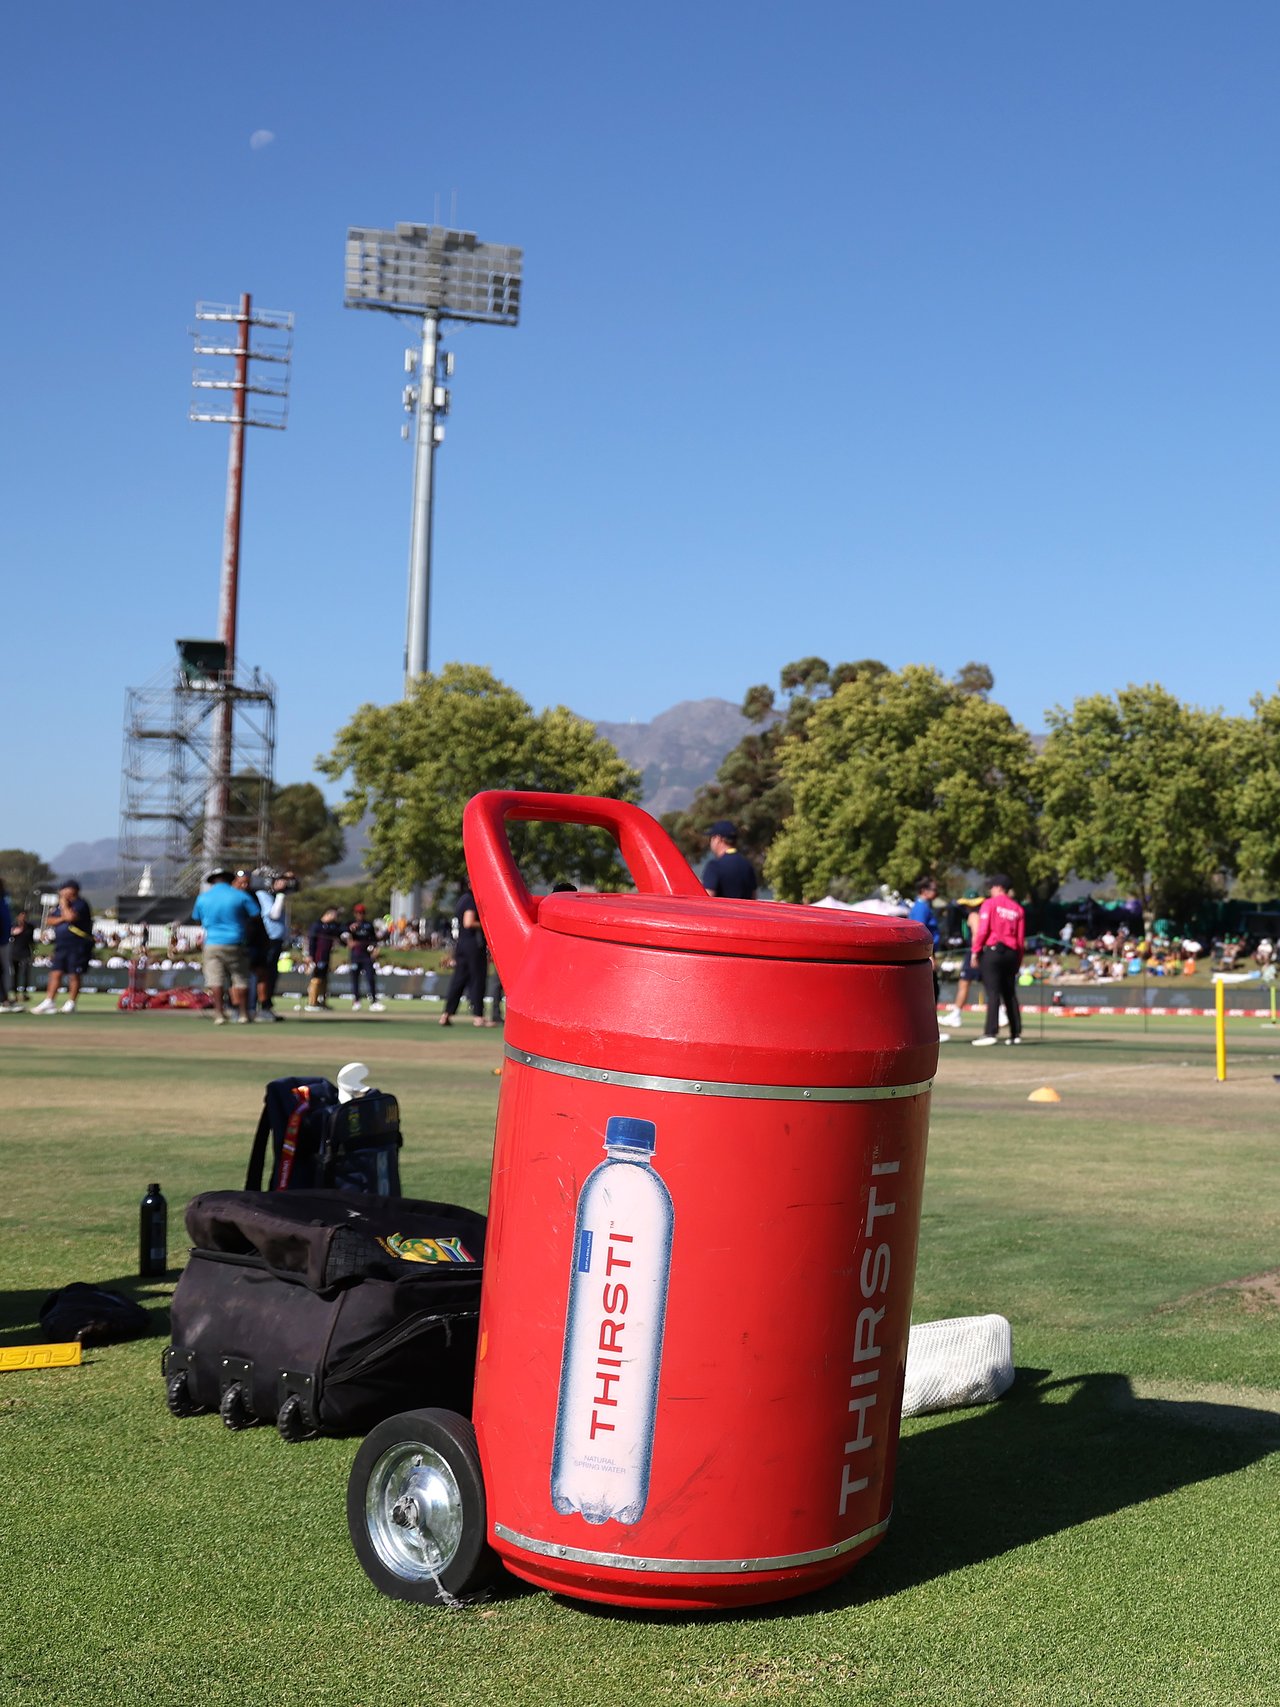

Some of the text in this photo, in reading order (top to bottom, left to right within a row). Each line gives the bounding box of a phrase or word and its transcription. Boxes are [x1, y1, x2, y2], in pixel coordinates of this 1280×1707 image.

[590, 1233, 634, 1440] THIRSTI
[838, 1160, 900, 1516] THIRSTI
[574, 1460, 626, 1474] SPRING WATER
[583, 1455, 616, 1465] NATURAL
